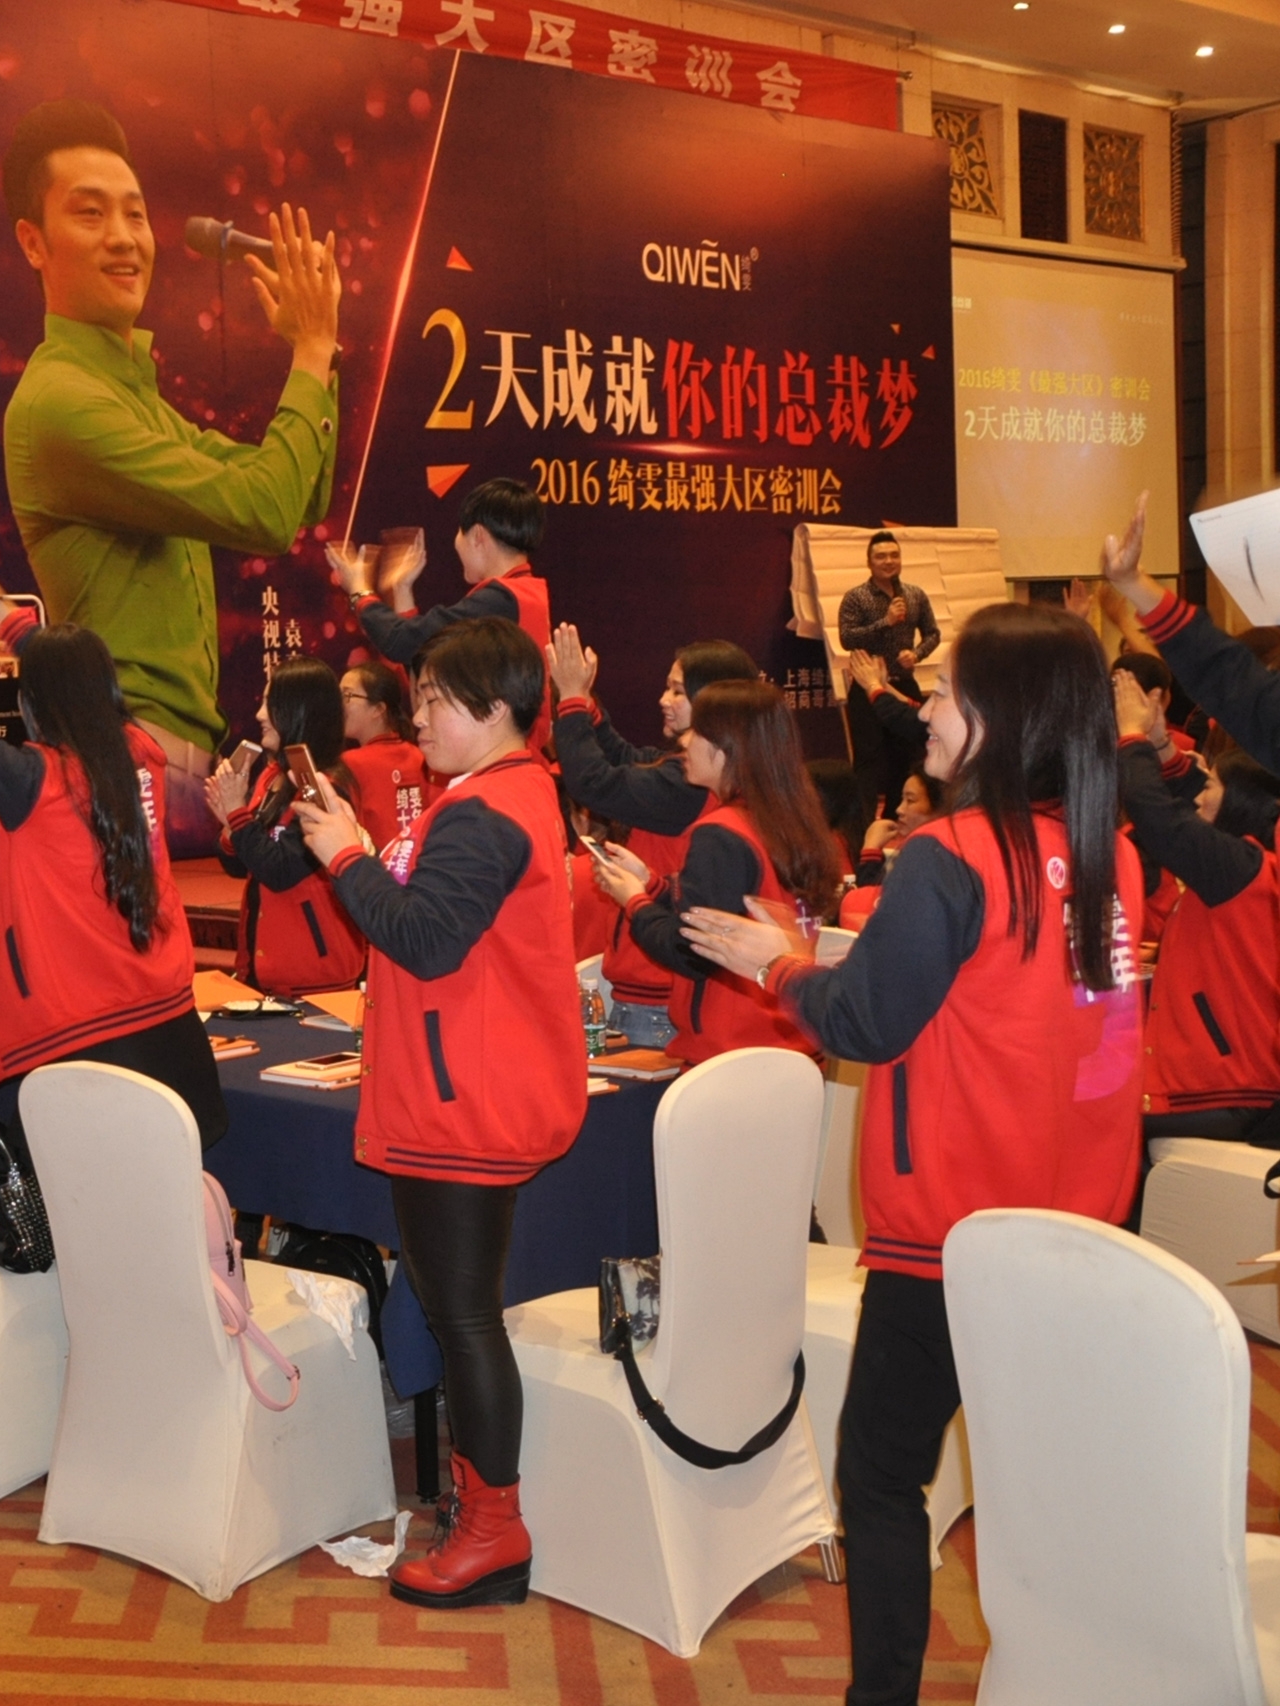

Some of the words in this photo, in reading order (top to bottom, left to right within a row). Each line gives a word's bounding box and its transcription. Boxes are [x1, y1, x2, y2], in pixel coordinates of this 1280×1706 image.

[421, 308, 919, 450] 2天成就你的总裁梦
[964, 405, 1148, 447] 2天成就你的总裁梦
[284, 618, 302, 660] 袁
